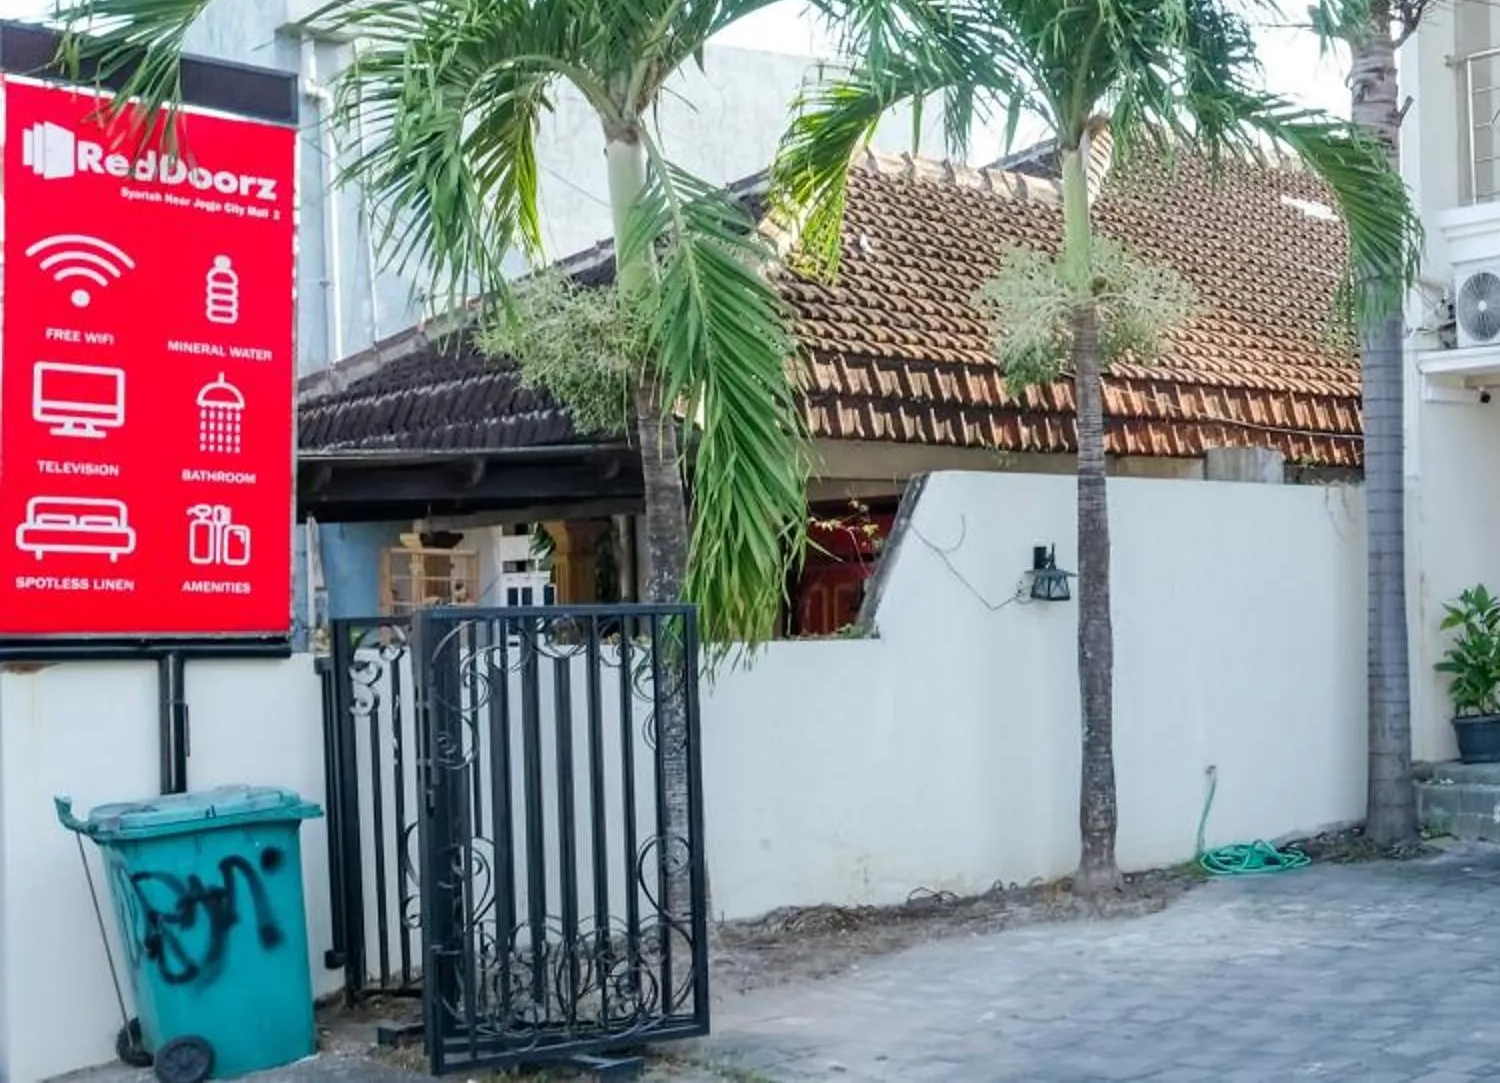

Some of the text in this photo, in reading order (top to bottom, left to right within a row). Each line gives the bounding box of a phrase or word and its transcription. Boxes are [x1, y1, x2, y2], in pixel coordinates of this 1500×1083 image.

[77, 140, 278, 201] RedDoorz
[120, 186, 162, 203] Syariah
[165, 192, 191, 208] Near
[193, 197, 222, 213] Jogja
[224, 202, 246, 217] City
[247, 205, 269, 219] Mall
[45, 327, 81, 342] FREE
[167, 340, 273, 362] MINERAL WATER
[36, 460, 119, 476] TELEVISION
[181, 469, 256, 484] BATHROOM
[15, 576, 135, 592] SPOTLESS LINEN
[181, 580, 251, 594] AMENITIES
